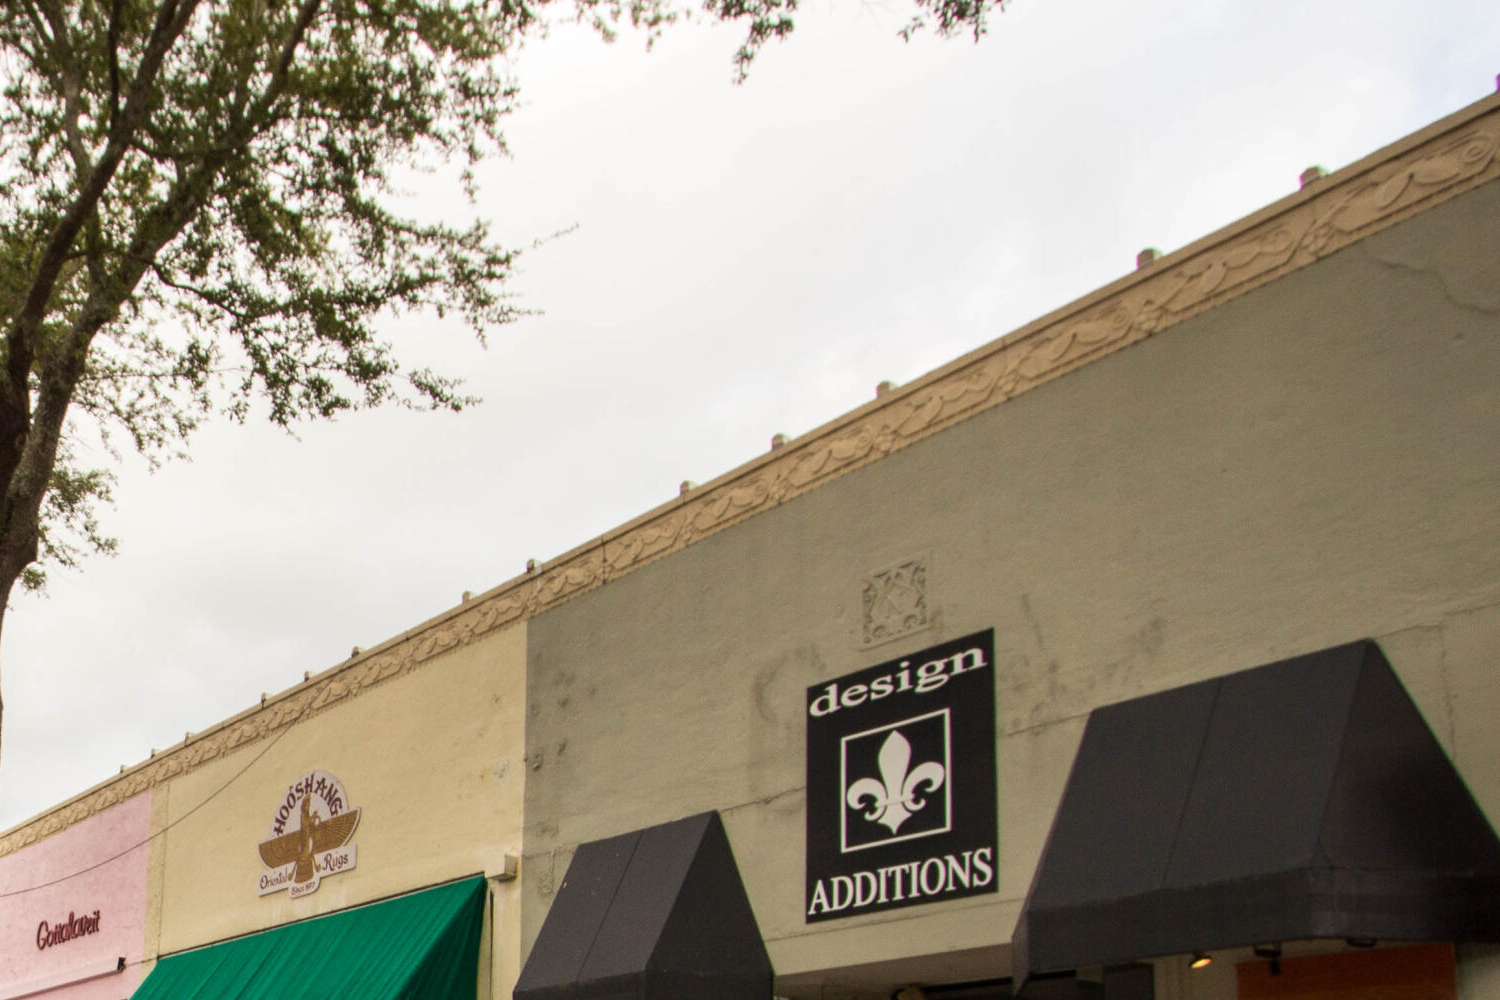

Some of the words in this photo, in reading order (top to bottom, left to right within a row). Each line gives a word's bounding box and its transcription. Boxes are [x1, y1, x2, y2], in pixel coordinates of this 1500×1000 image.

[809, 647, 988, 717] design
[273, 773, 343, 836] HOOSHANG
[260, 866, 288, 890] Oriental
[322, 852, 349, 872] Rugs
[807, 847, 994, 915] ADDITIONS
